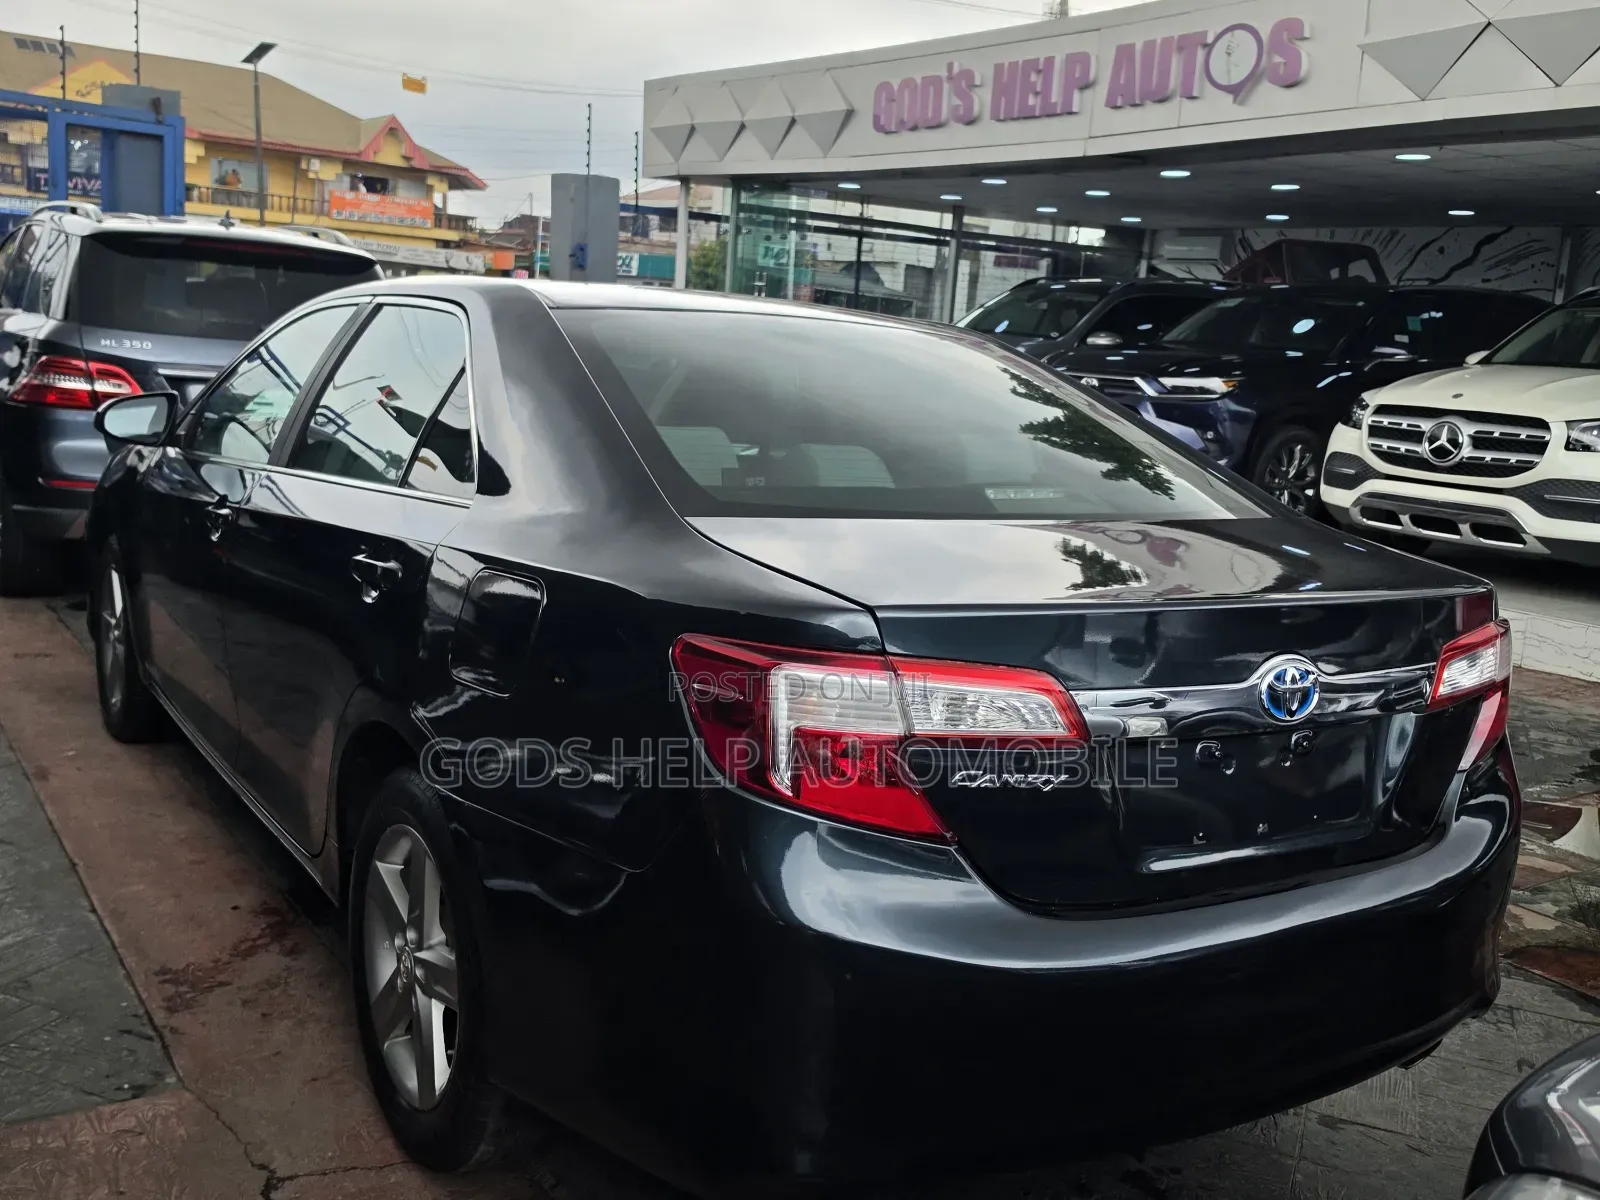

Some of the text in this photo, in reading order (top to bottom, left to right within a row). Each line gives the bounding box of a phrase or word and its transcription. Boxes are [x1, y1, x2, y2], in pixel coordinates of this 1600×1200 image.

[873, 61, 982, 133] GOD'S
[990, 51, 1096, 121] HELP
[101, 338, 152, 350] ML 350
